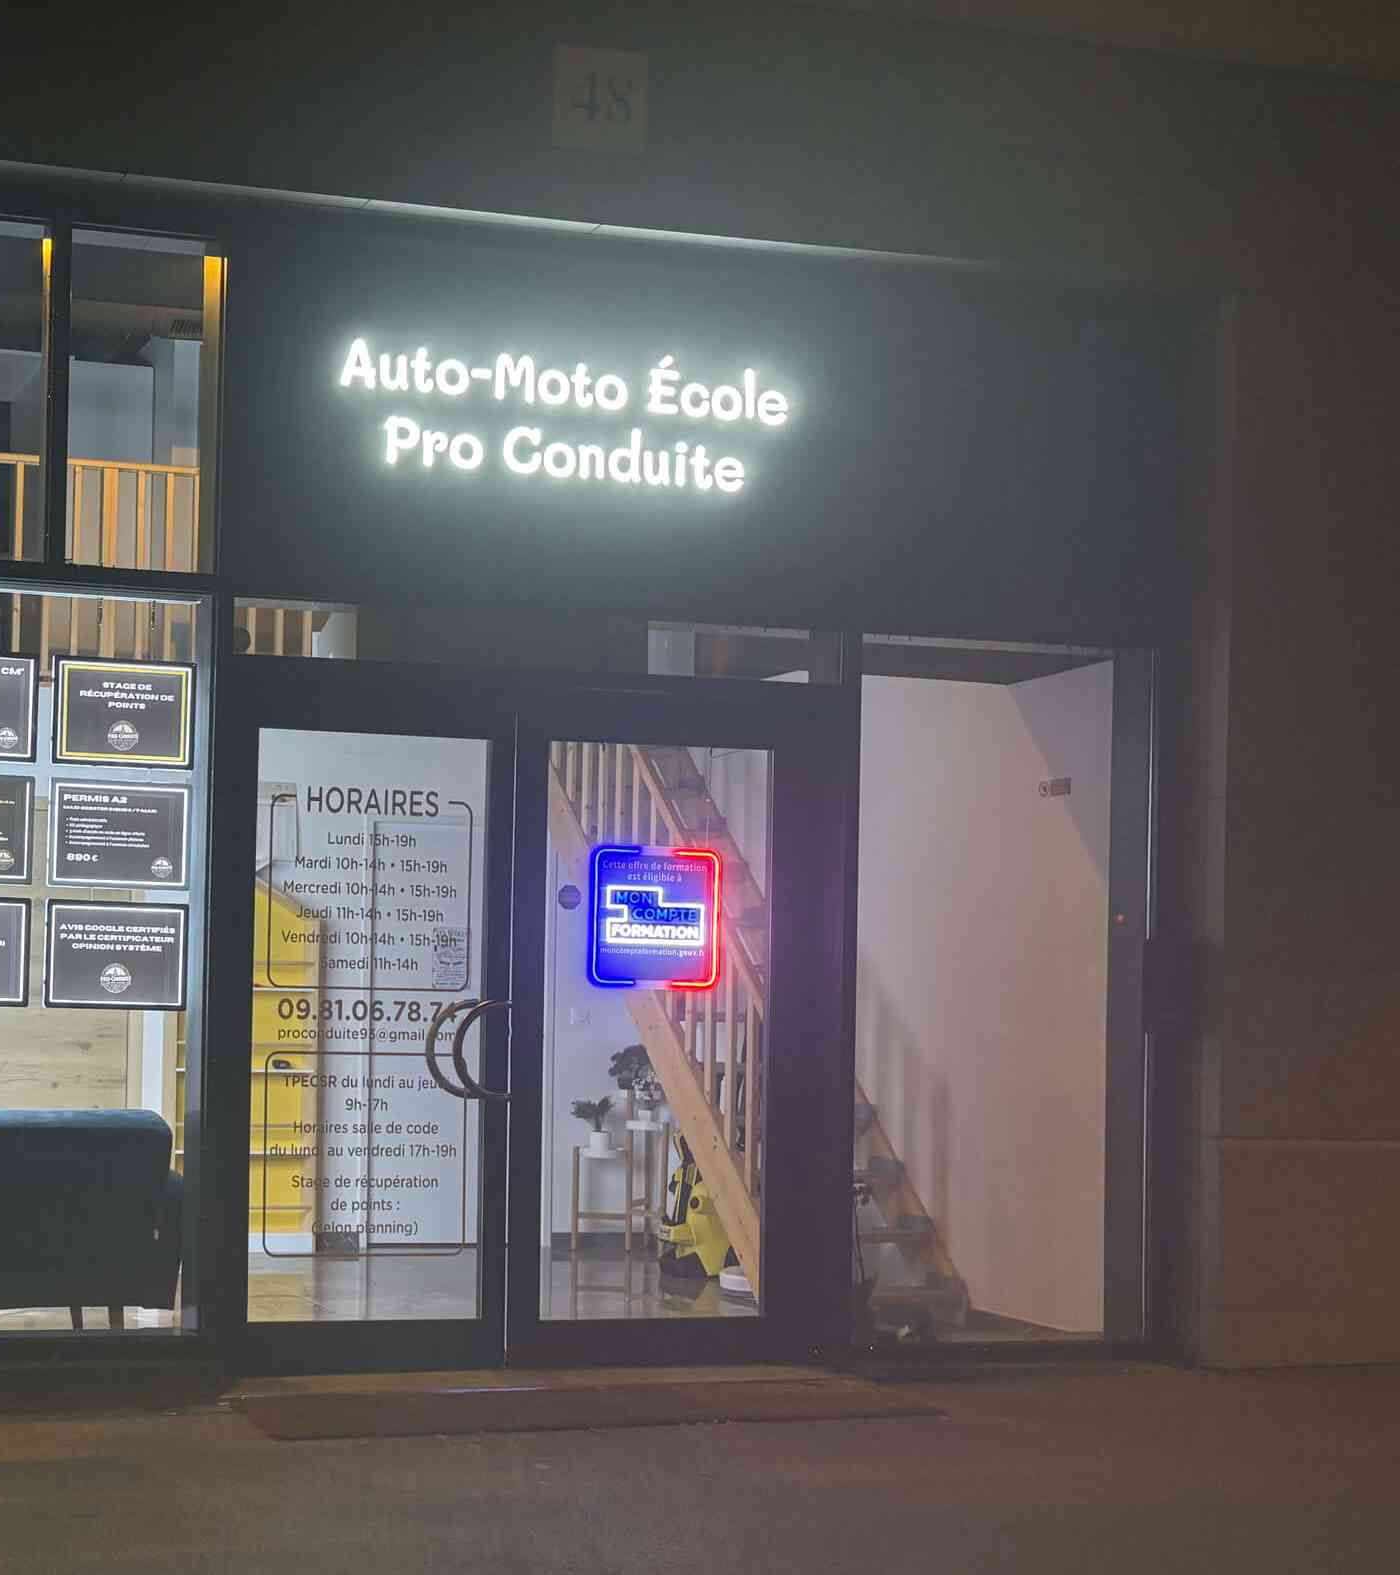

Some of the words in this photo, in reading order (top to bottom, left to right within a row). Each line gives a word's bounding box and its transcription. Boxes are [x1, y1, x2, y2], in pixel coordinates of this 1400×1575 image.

[340, 337, 628, 411] Auto-Moto
[647, 354, 788, 426] École
[384, 415, 485, 470] Pro
[503, 426, 745, 492] Conduite
[102, 682, 136, 690] STAGE
[80, 689, 159, 701] RÉCUPÉRATION
[108, 701, 146, 710] POINTS
[63, 794, 110, 803] PERMIS
[111, 796, 128, 804] A2
[306, 785, 440, 818] HORAIRES
[327, 832, 365, 846] Lundi
[369, 833, 417, 848] 15h-19h
[294, 856, 332, 870] Mardi
[336, 857, 386, 872] 10h-14h
[400, 859, 448, 874] 15h-19h
[651, 861, 662, 872] de
[663, 861, 706, 874] formation
[282, 880, 341, 895] Mercredi
[346, 882, 396, 897] 10h-14h
[410, 884, 457, 899] 15h-19h
[616, 891, 653, 905] MON
[295, 905, 332, 920] Jeudi
[336, 906, 382, 921] 11h-14h
[396, 908, 444, 923] 15h-19h
[632, 907, 698, 922] COMPTE
[60, 923, 83, 931] AVIS
[85, 924, 124, 933] GOOGLE
[125, 926, 176, 935] CERTIFIÉS
[611, 923, 699, 939] FORMATION
[97, 934, 175, 944] CERTIFICATEUR
[281, 929, 341, 945] Vendredi
[346, 931, 395, 946] 10h-14h
[409, 933, 457, 948] 15h-19h
[72, 943, 114, 951] OPINION
[320, 956, 369, 971] Samedi
[374, 957, 419, 972] 11h-14h
[284, 1074, 338, 1089] TPECSR
[341, 1074, 358, 1089] du
[362, 1075, 395, 1090] lundi
[399, 1077, 415, 1090] au
[416, 1075, 452, 1092] jeu
[345, 1098, 389, 1112] 9h-7h
[293, 1120, 348, 1135] Horaires
[386, 1121, 402, 1135] de
[406, 1121, 439, 1135] code
[269, 1143, 287, 1157] du
[290, 1143, 322, 1157] lund
[327, 1145, 343, 1157] au
[347, 1143, 405, 1158] vendredi
[410, 1143, 457, 1159] 17h-19h
[291, 1174, 330, 1191] Stage
[334, 1174, 351, 1189] de
[355, 1173, 439, 1192] récupération
[330, 1198, 347, 1212] de
[351, 1198, 393, 1214] points
[311, 1220, 352, 1236] (elon
[356, 1220, 418, 1237] planning)
